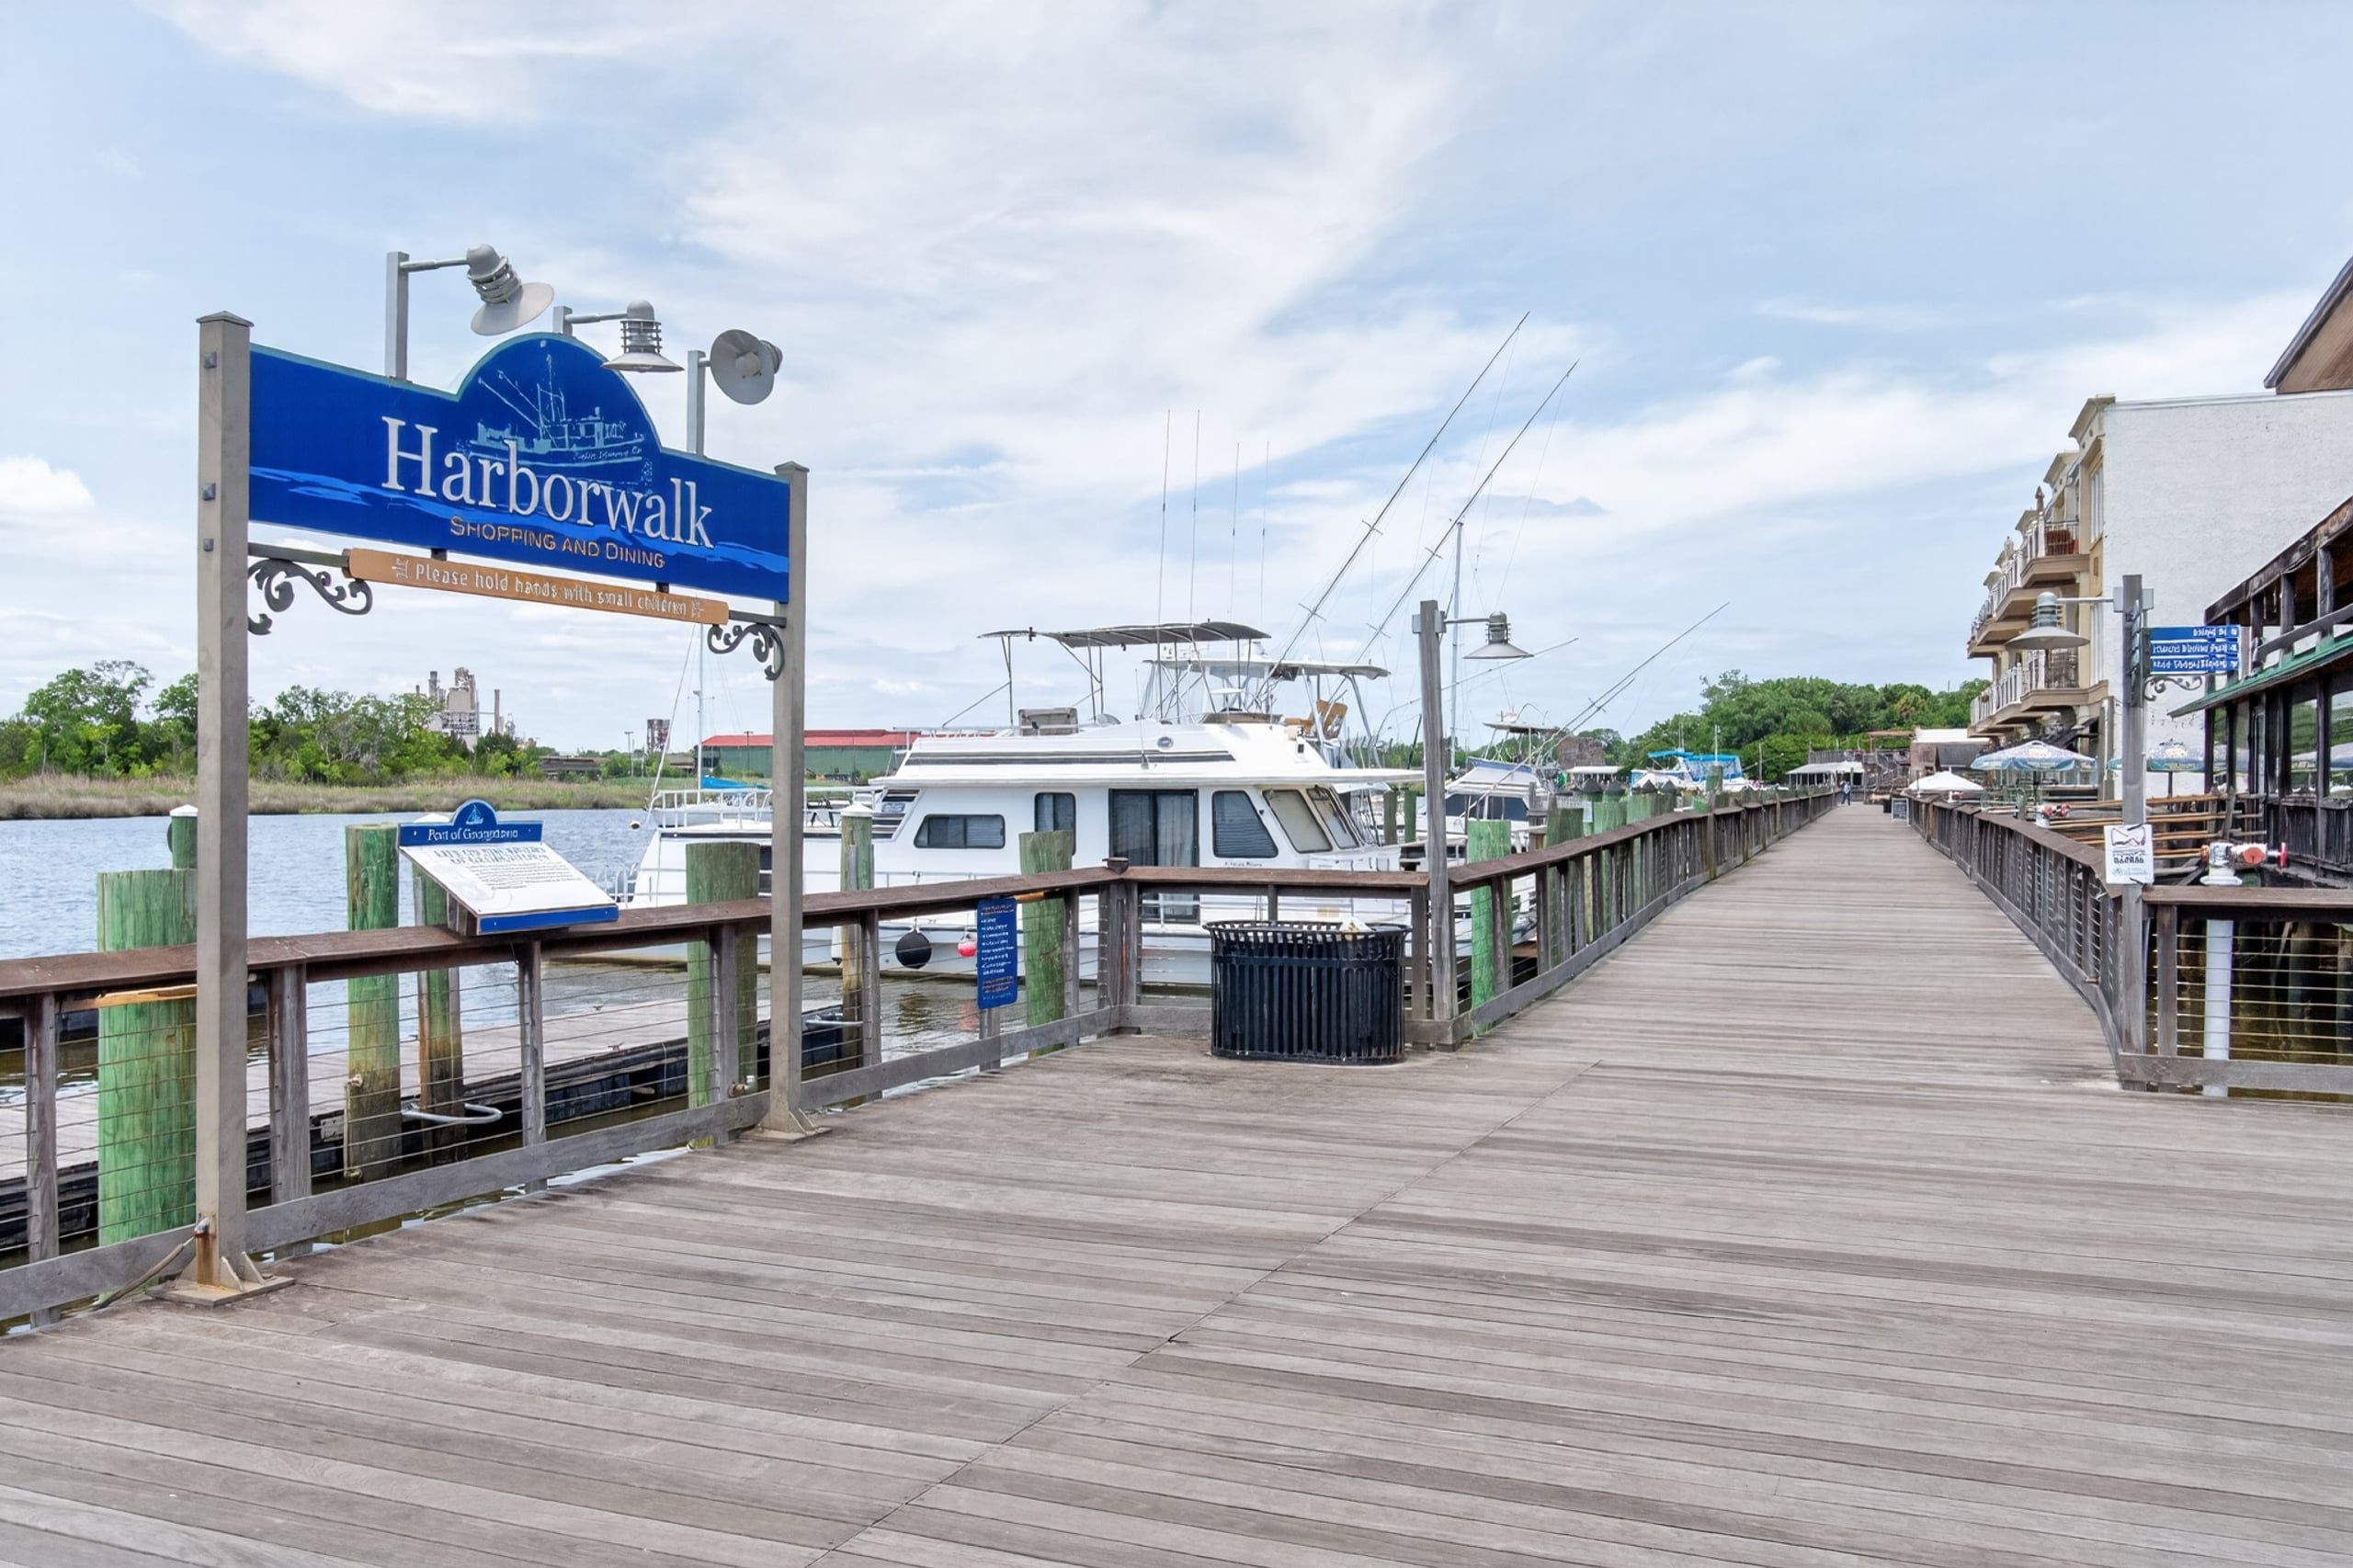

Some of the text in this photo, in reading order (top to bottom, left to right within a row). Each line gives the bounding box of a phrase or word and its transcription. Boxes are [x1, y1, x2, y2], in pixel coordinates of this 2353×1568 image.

[381, 415, 714, 550] Harborwalk
[449, 515, 665, 568] SHOPPING AND DINING
[415, 562, 468, 586] Please
[475, 569, 508, 591] hold
[515, 576, 558, 597] hands
[563, 583, 593, 604] with
[597, 588, 632, 608] small
